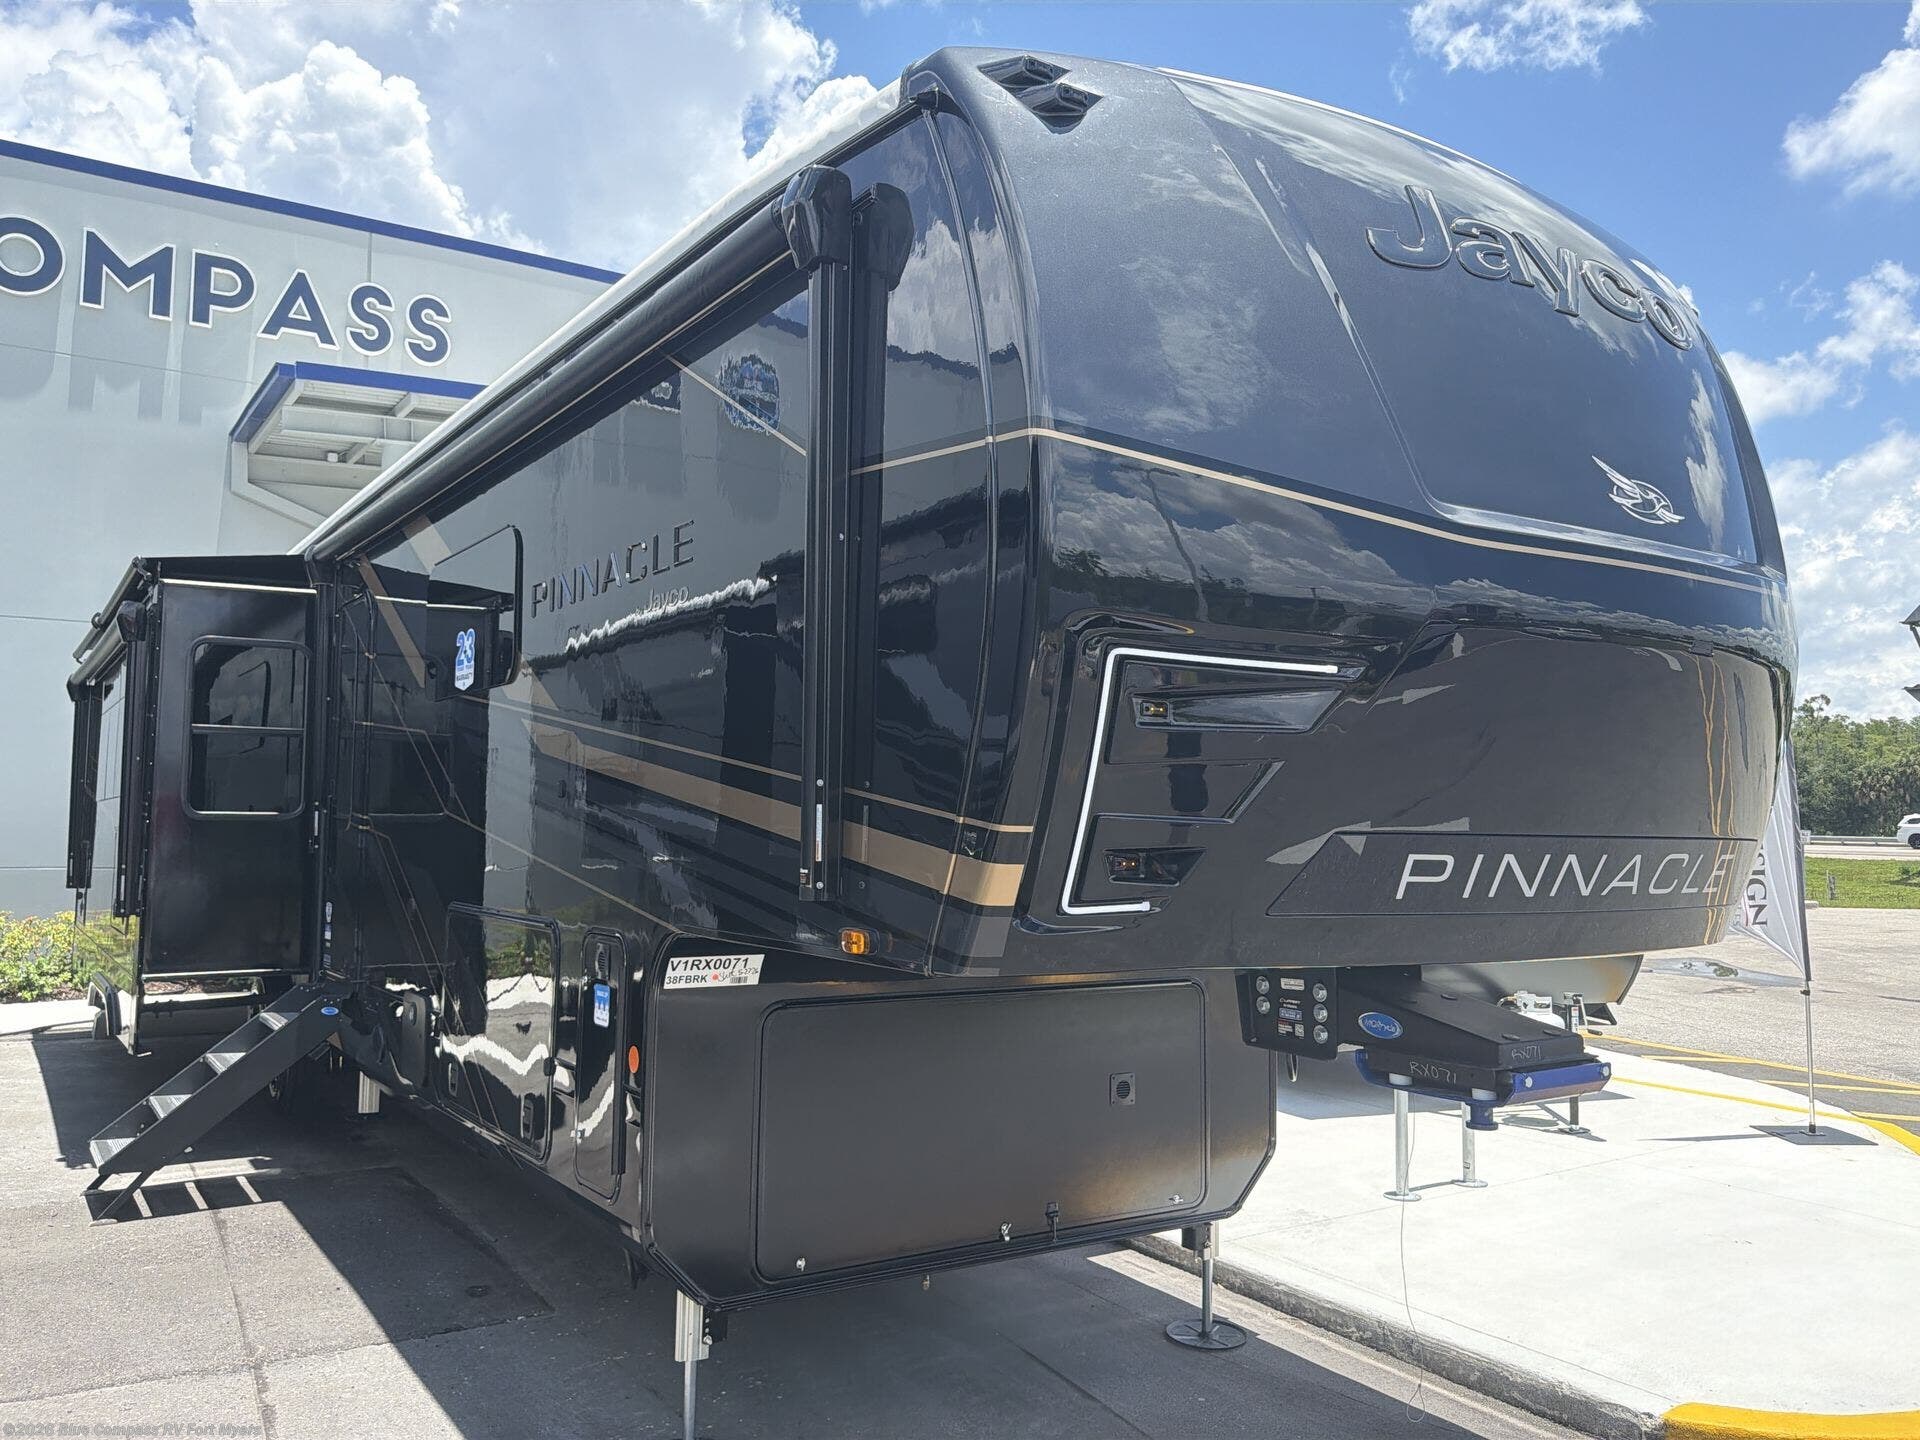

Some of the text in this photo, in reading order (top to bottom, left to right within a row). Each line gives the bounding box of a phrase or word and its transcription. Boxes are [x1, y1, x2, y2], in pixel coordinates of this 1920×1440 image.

[0, 214, 452, 366] OMPASS
[1366, 184, 1692, 351] Jayco
[531, 519, 695, 618] PINNACLE
[1396, 853, 1735, 900] PINNACLE
[665, 974, 708, 985] 38FBRK
[670, 957, 749, 972] V1RX0071
[1409, 1061, 1457, 1085] RX071
